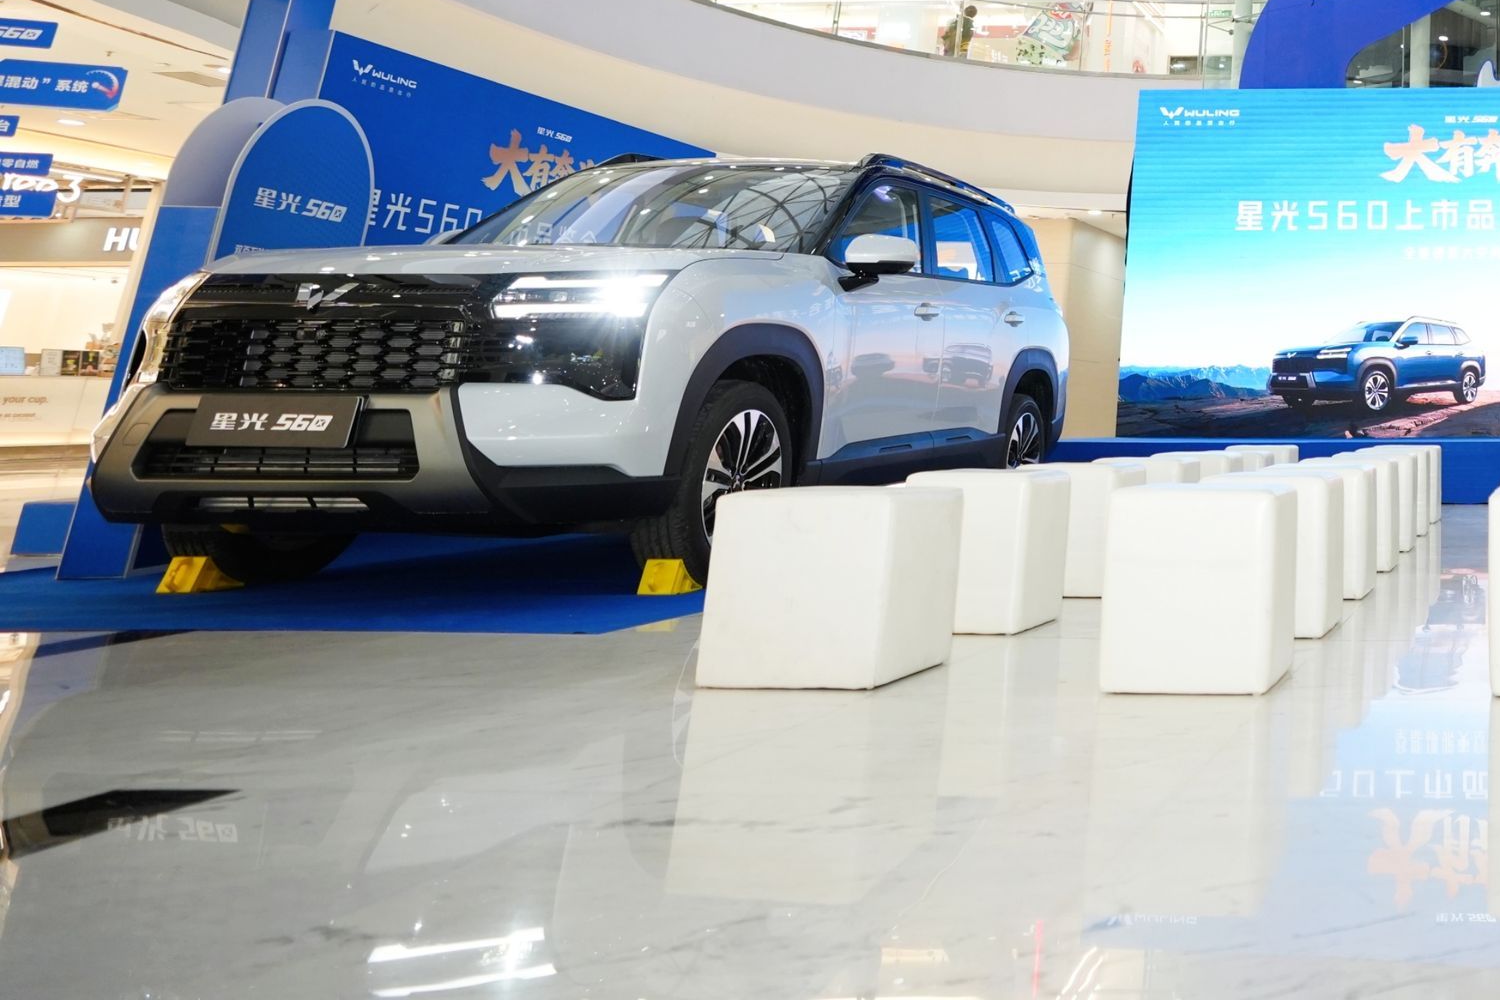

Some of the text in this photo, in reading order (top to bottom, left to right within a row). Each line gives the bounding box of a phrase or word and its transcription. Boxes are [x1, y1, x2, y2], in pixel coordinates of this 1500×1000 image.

[0, 75, 89, 94] 混动”系统
[372, 69, 418, 89] WULING
[1184, 109, 1240, 117] WULING
[0, 158, 39, 169] 零自燃
[481, 128, 595, 198] 大有奔
[253, 187, 348, 223] 星光 560
[209, 412, 333, 432] 星光 560
